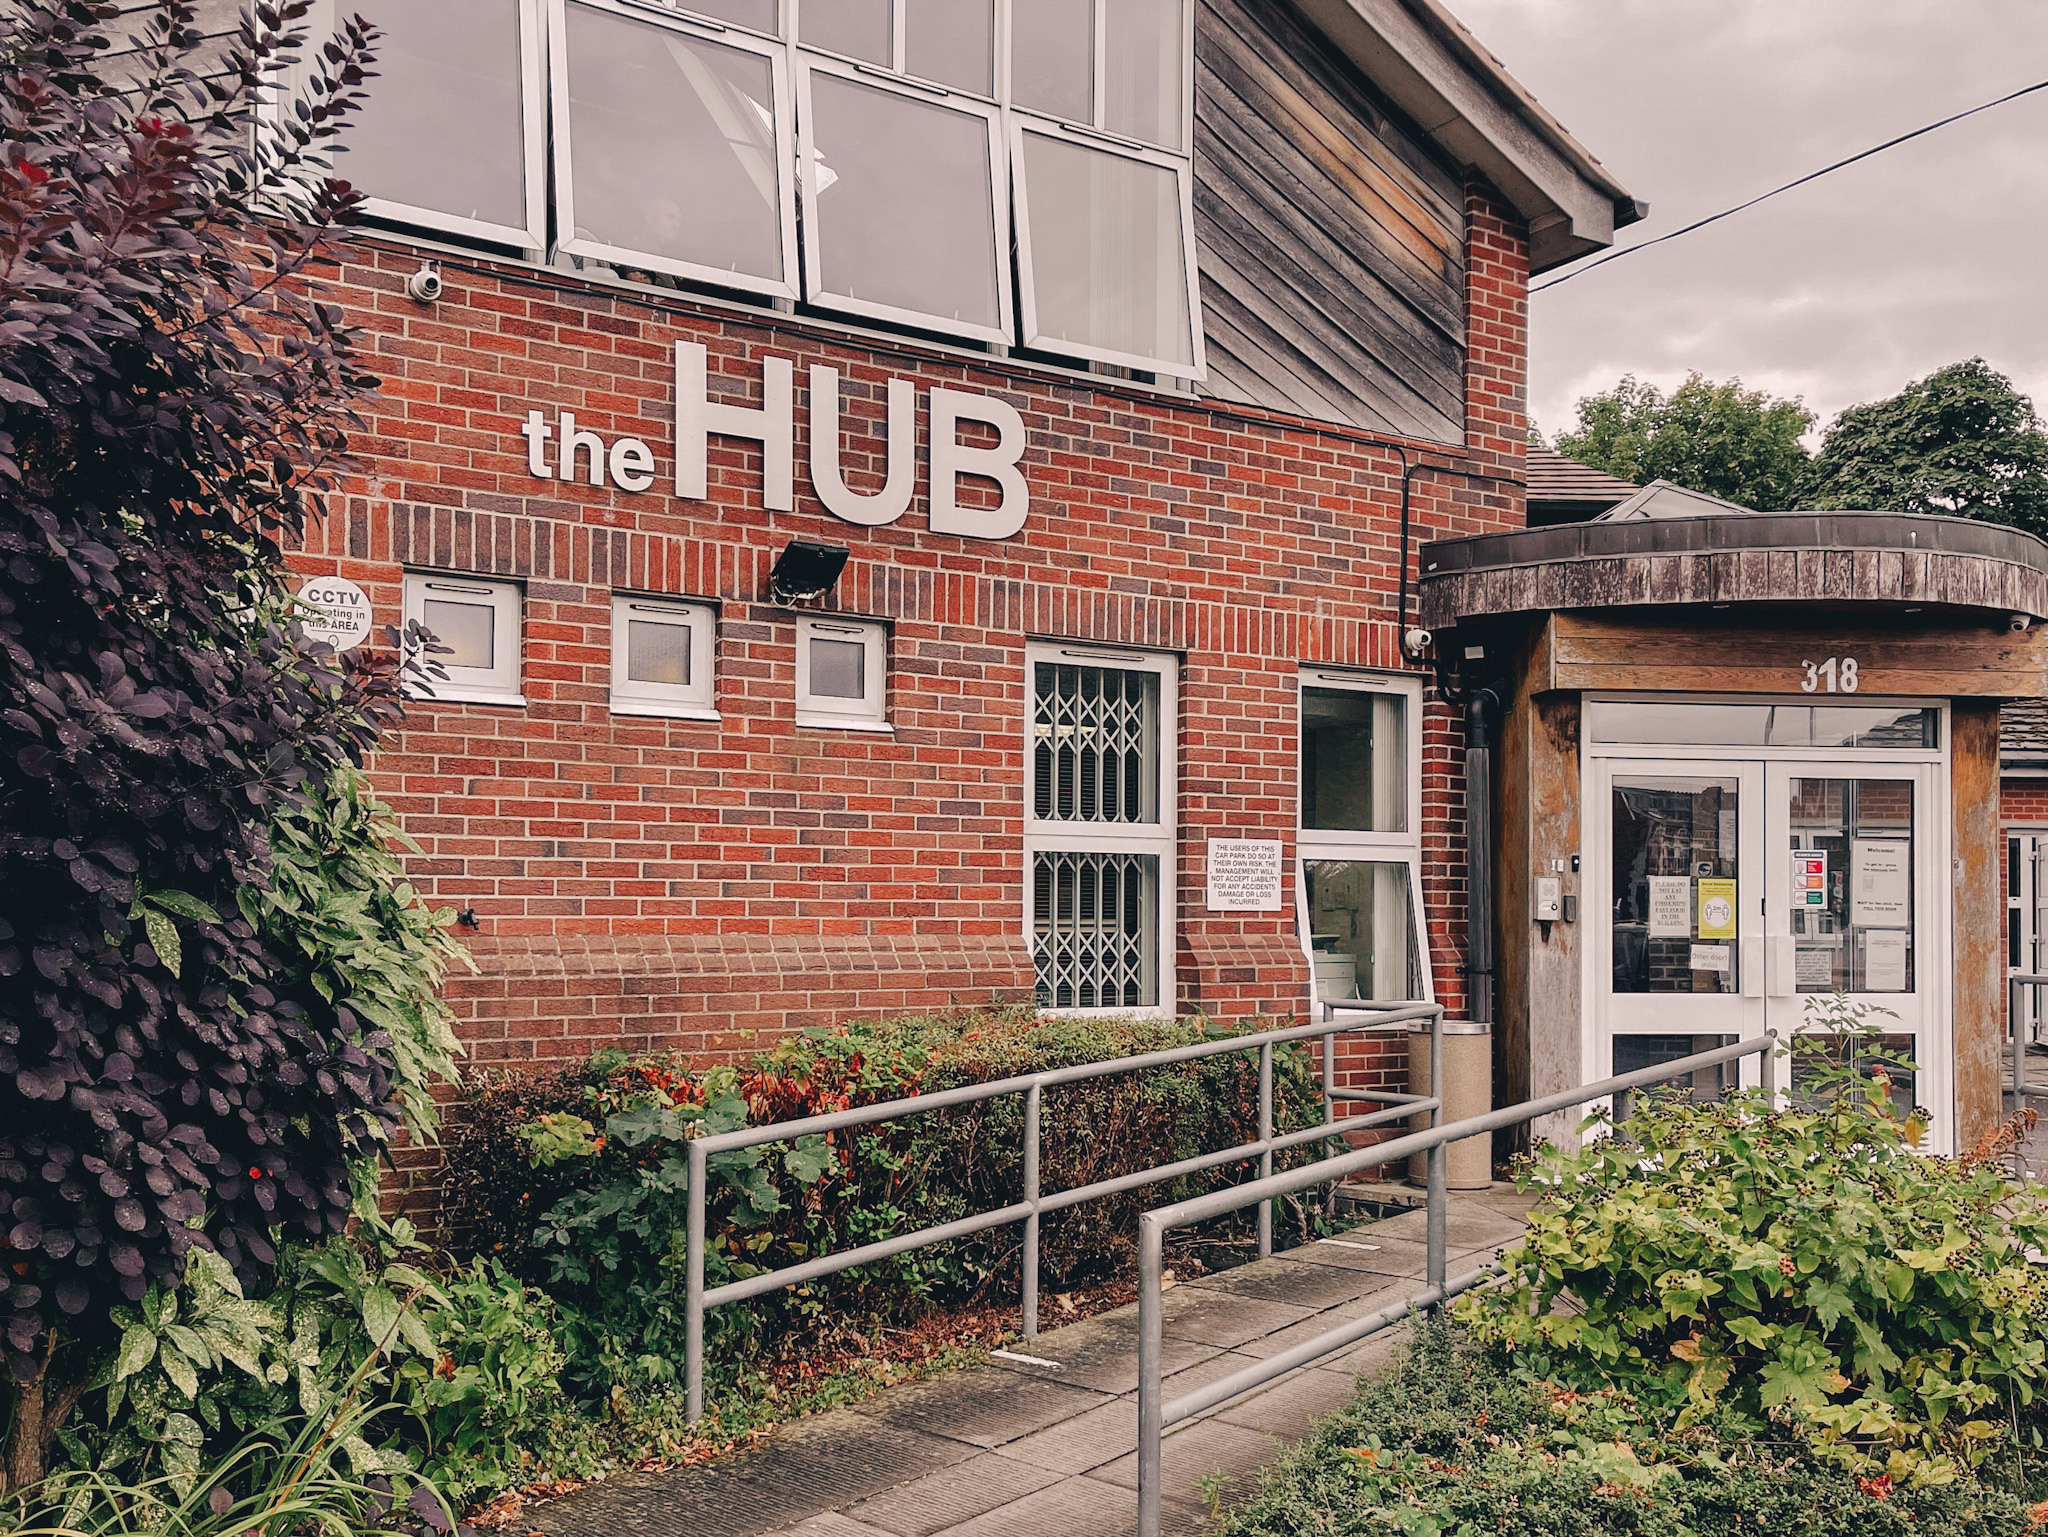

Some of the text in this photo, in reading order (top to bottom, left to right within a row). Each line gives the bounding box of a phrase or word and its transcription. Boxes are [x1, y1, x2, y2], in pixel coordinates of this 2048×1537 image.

[522, 339, 1030, 540] the HUB
[308, 588, 360, 605] CCTV
[356, 610, 365, 619] in
[331, 620, 359, 631] AREA
[1800, 656, 1859, 693] 318
